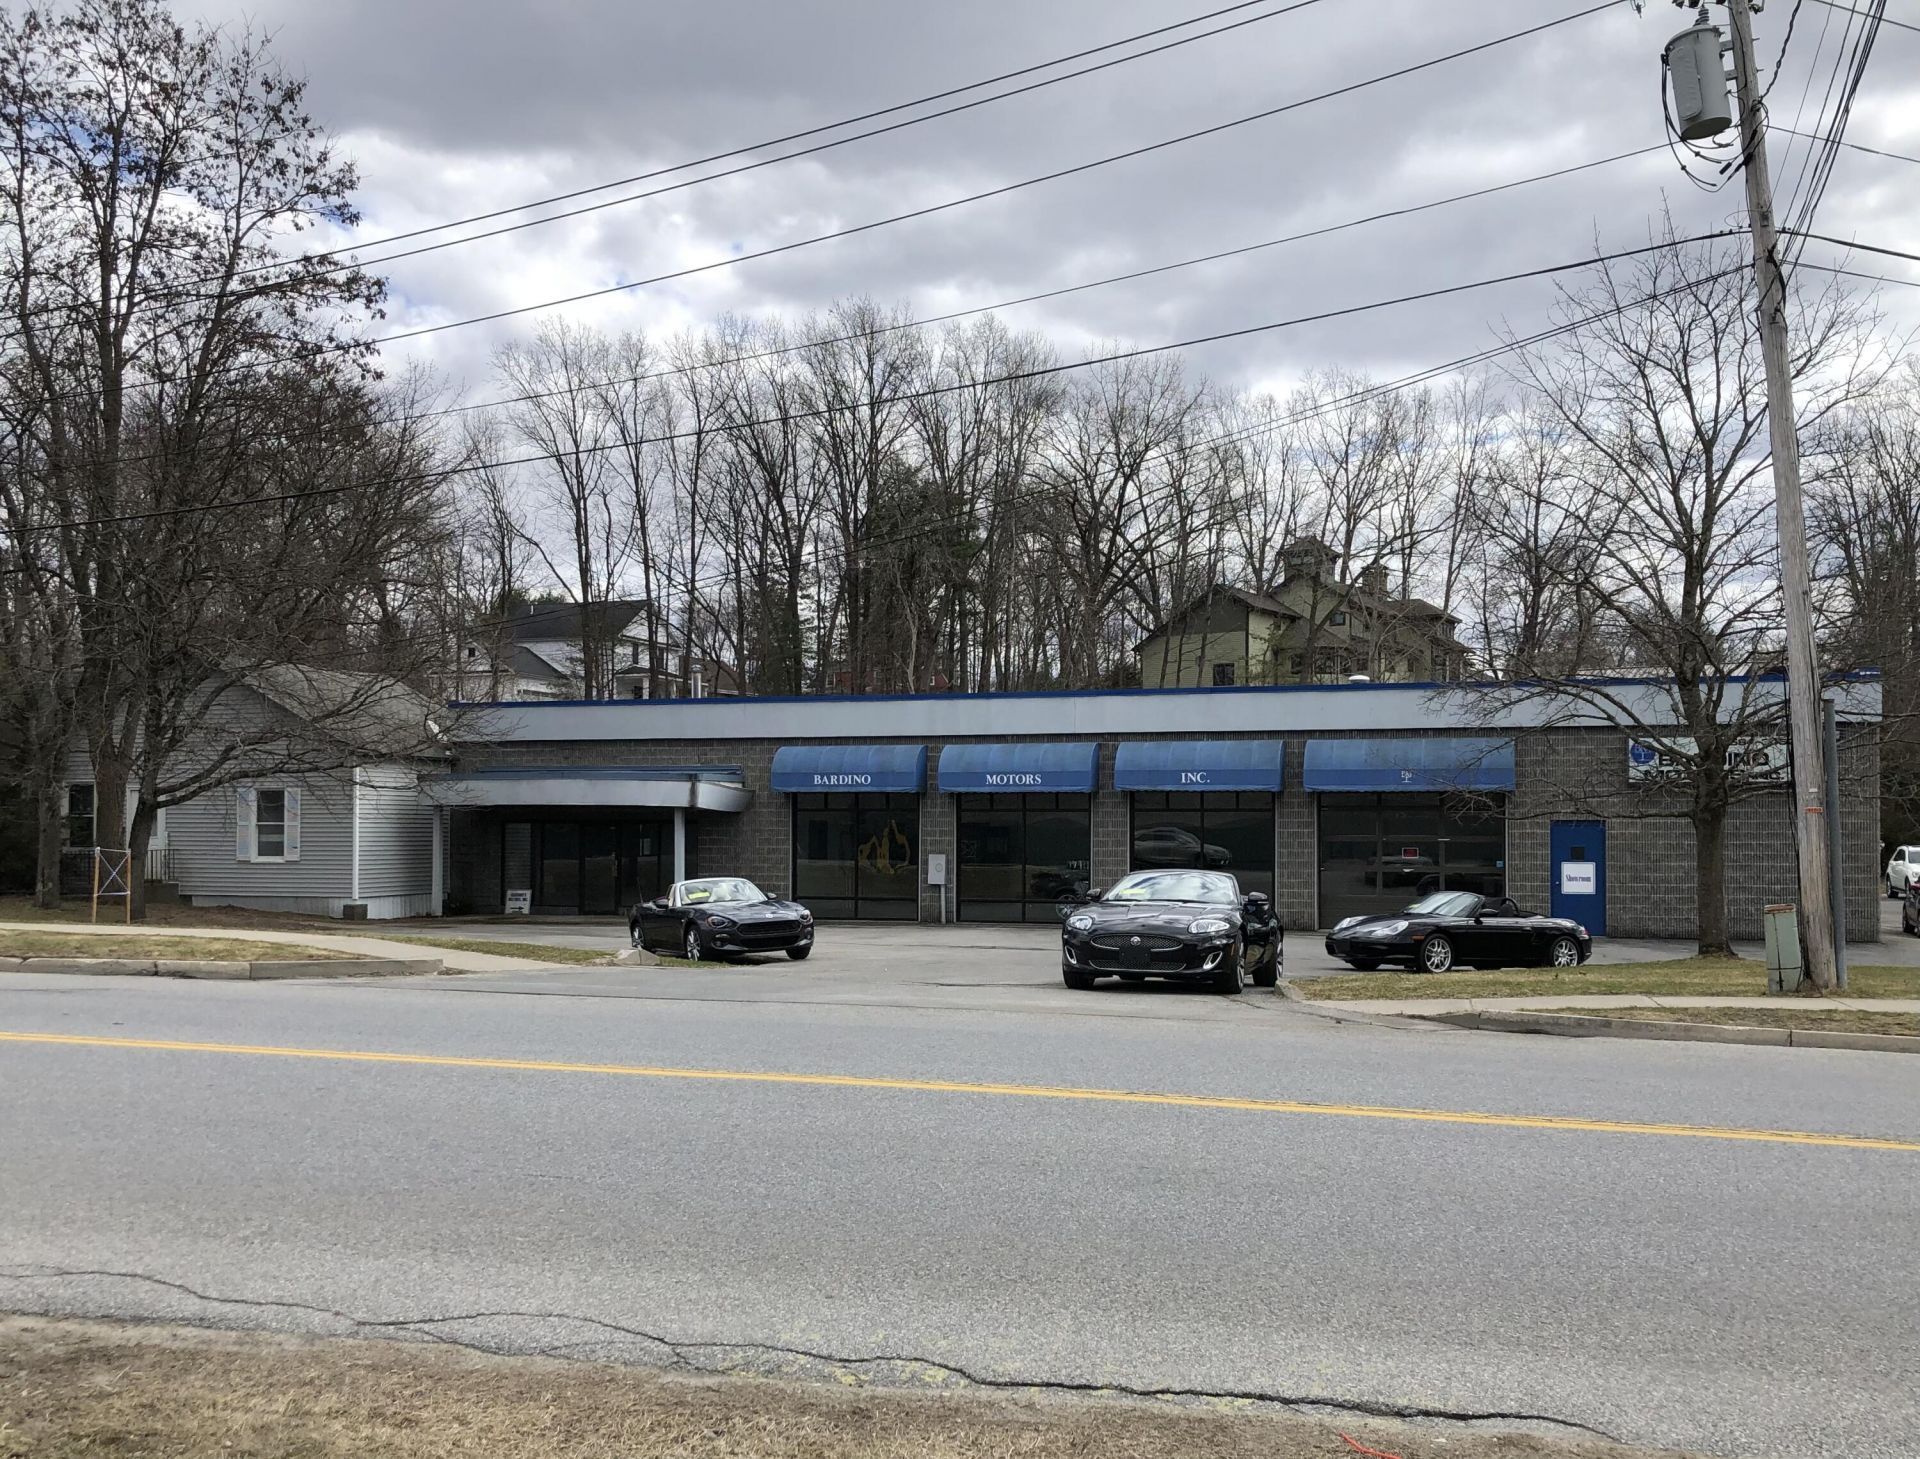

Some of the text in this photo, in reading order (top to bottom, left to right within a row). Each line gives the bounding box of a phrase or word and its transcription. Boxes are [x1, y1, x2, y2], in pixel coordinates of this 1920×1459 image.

[813, 774, 871, 785] BARDINO
[985, 774, 1042, 785] MOTORS
[1180, 772, 1210, 783] INC.
